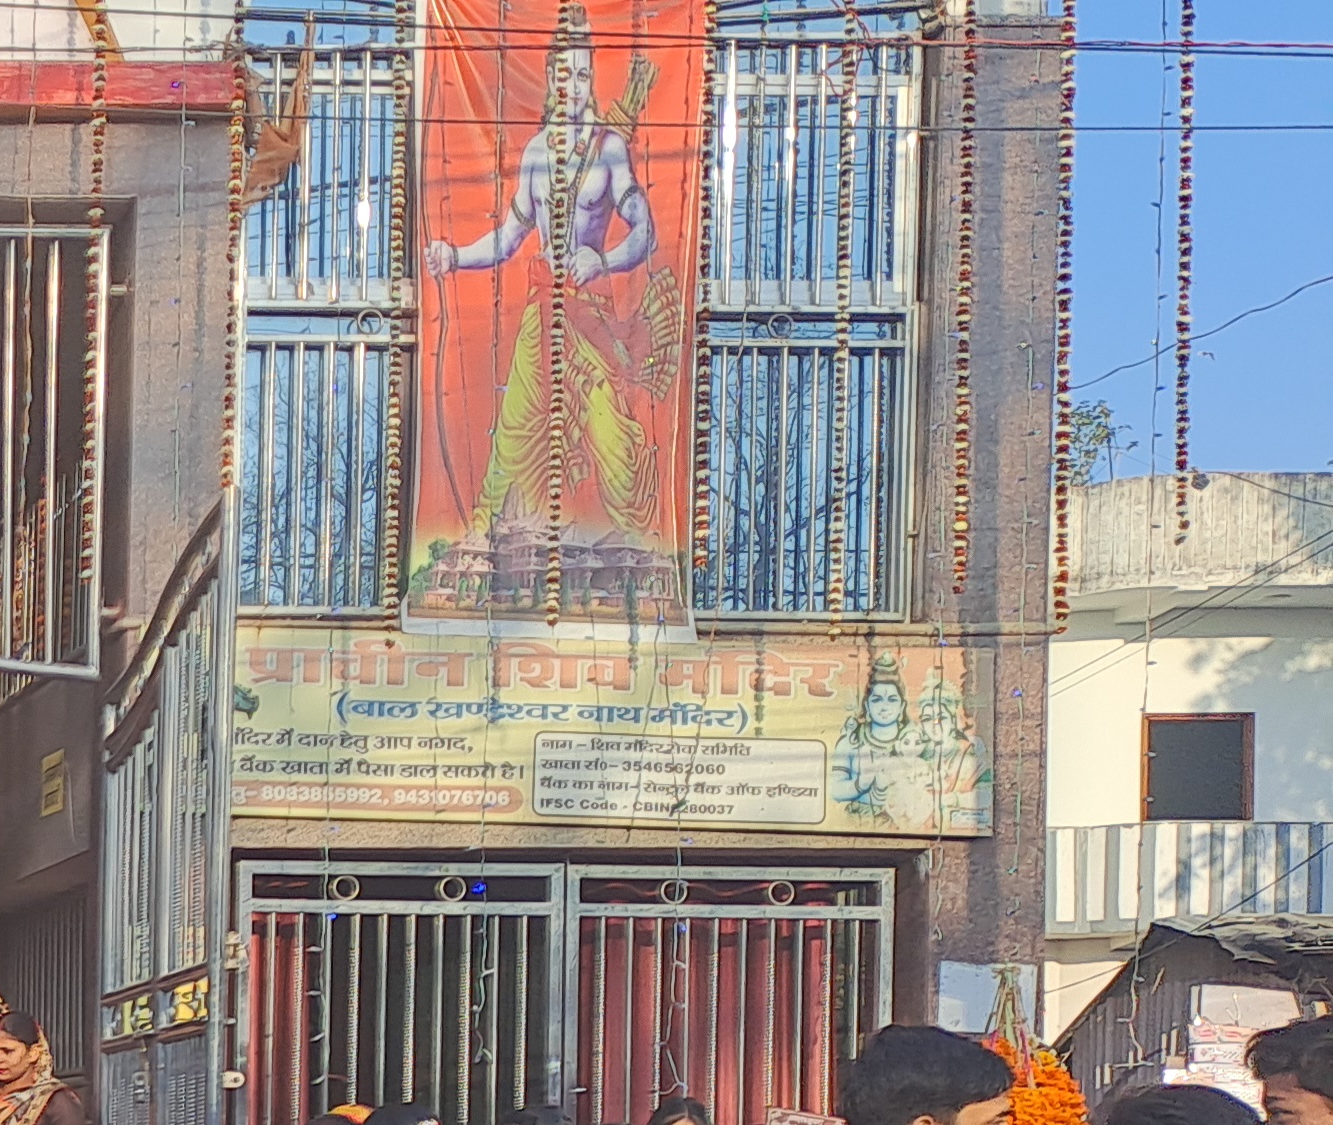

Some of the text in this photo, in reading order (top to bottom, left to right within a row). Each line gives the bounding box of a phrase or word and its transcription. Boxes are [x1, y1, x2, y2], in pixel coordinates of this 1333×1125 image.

[245, 639, 473, 687] प्राचीन
[490, 642, 635, 691] शिव
[577, 702, 643, 724] नाथ
[275, 727, 295, 747] में
[296, 733, 335, 748] दान
[373, 735, 413, 750] आप
[278, 760, 330, 775] खाता
[334, 757, 353, 776] में
[356, 757, 396, 777] पैसा
[399, 763, 439, 779] डाल
[540, 758, 580, 771] खाता
[572, 779, 595, 791] का
[540, 797, 575, 810] IFSC
[579, 799, 618, 811] Code
